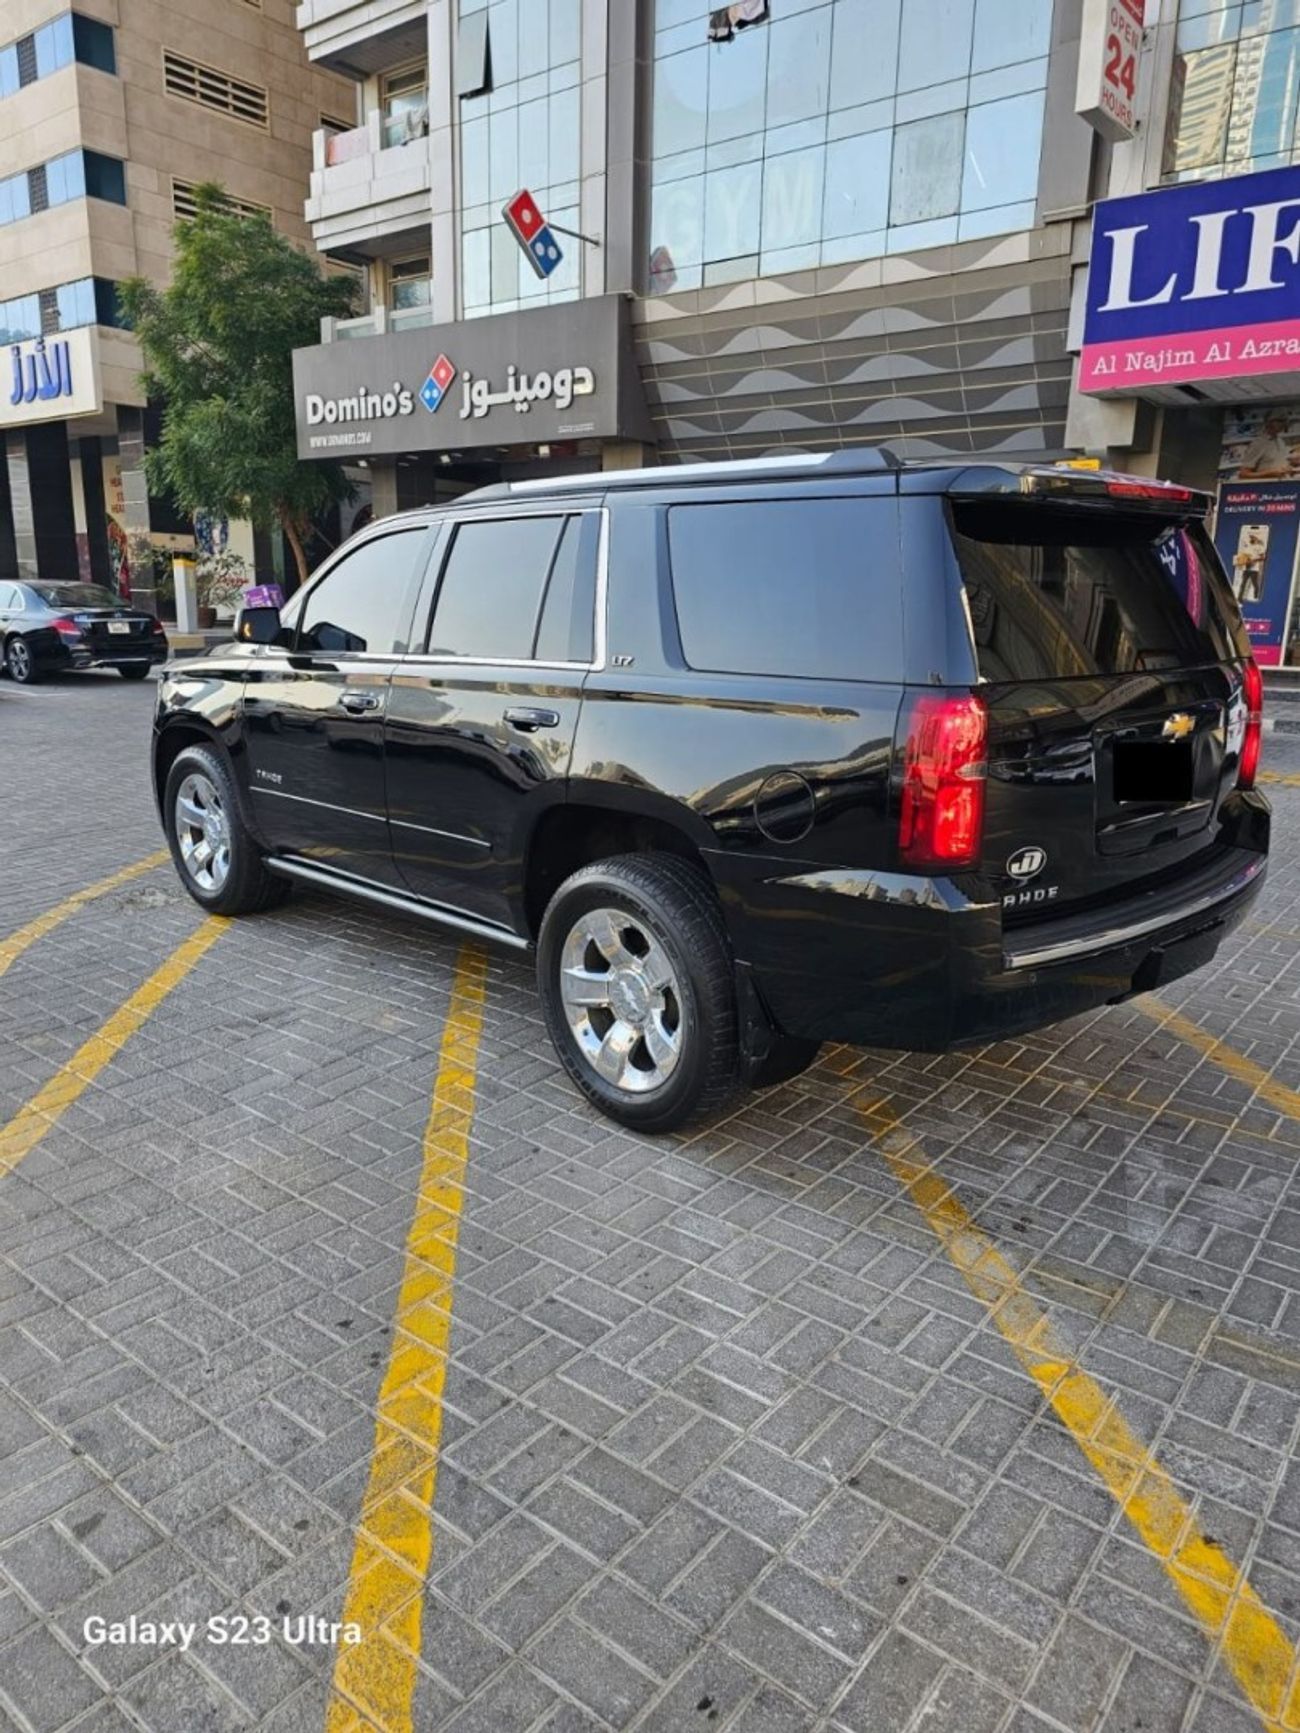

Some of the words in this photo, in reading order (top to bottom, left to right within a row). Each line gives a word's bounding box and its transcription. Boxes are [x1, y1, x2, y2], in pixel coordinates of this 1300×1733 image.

[1110, 6, 1140, 51] OPEN
[1104, 32, 1136, 101] 24
[1101, 86, 1133, 129] HOURS
[1091, 355, 1118, 375] Al
[1124, 349, 1196, 373] Najim
[1203, 341, 1231, 364] Al
[305, 380, 414, 425] Domino's
[459, 364, 596, 419] دومينوز
[1224, 505, 1257, 513] DELIVERY
[1002, 886, 1059, 908] AHOE
